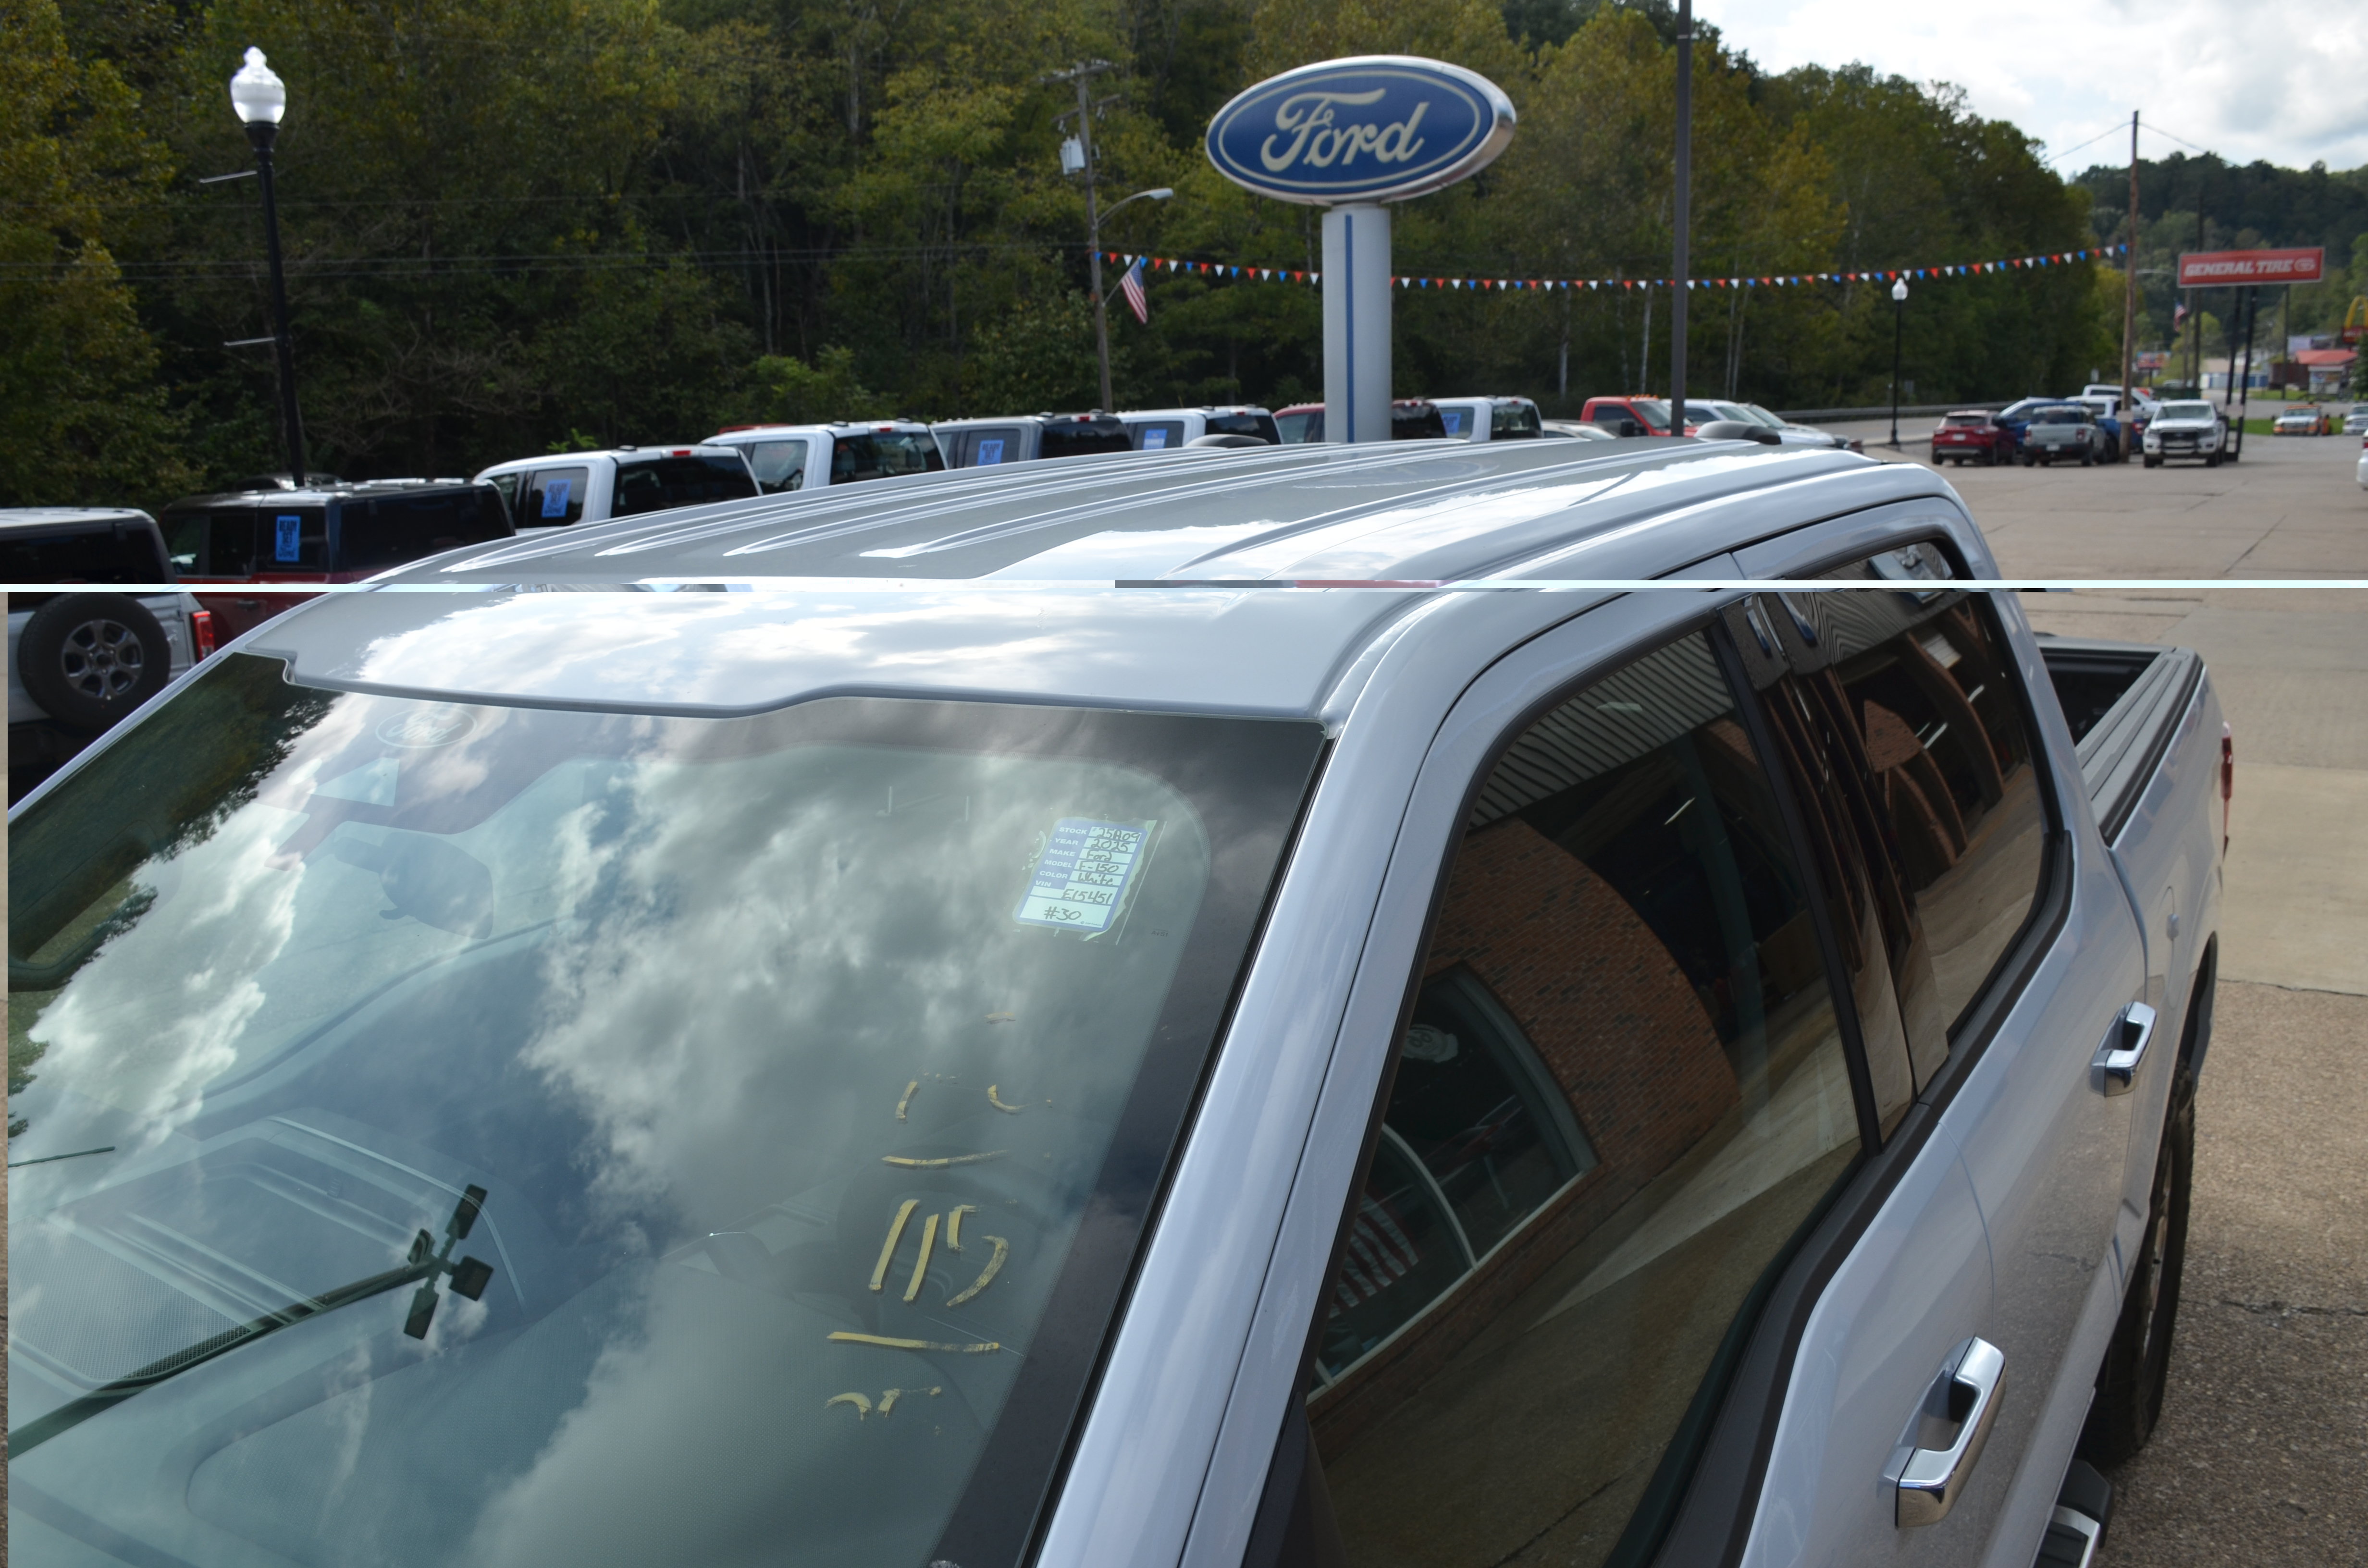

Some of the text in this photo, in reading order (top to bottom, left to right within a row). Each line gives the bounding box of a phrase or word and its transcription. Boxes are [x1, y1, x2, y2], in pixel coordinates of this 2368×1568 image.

[1260, 88, 1430, 172] Ford
[2184, 261, 2254, 277] GENERAL
[2256, 259, 2294, 273] TIRE
[385, 710, 462, 743] Ford
[1091, 838, 1131, 852] 2025
[1086, 849, 1112, 861] Ford
[1044, 859, 1119, 873] MODEL F-150
[1039, 870, 1113, 885] COLOR White
[1044, 906, 1082, 921] #30
